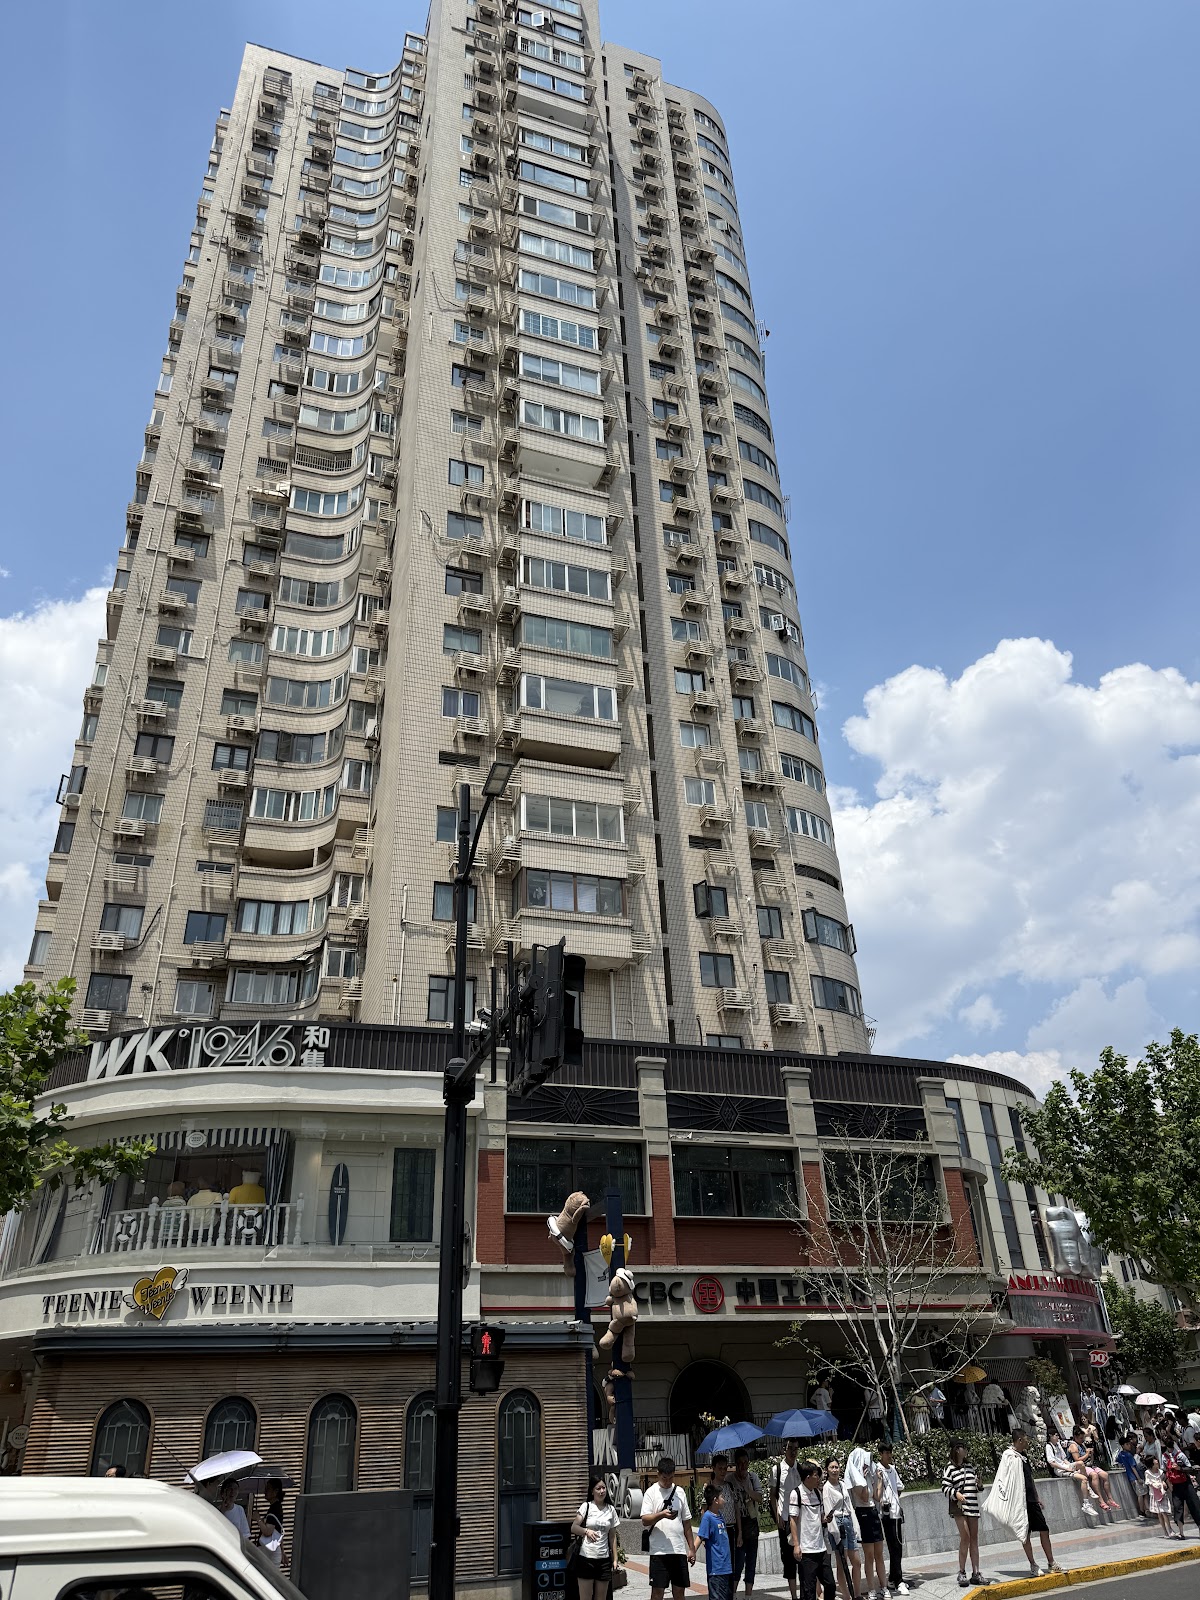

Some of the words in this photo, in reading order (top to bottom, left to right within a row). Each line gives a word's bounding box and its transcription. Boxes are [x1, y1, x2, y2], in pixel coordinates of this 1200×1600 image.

[42, 1290, 123, 1315] TEENIE
[190, 1284, 294, 1306] WEENIE
[141, 1280, 171, 1302] Teenie
[633, 1281, 685, 1304] CBC
[141, 1291, 175, 1315] Weenie
